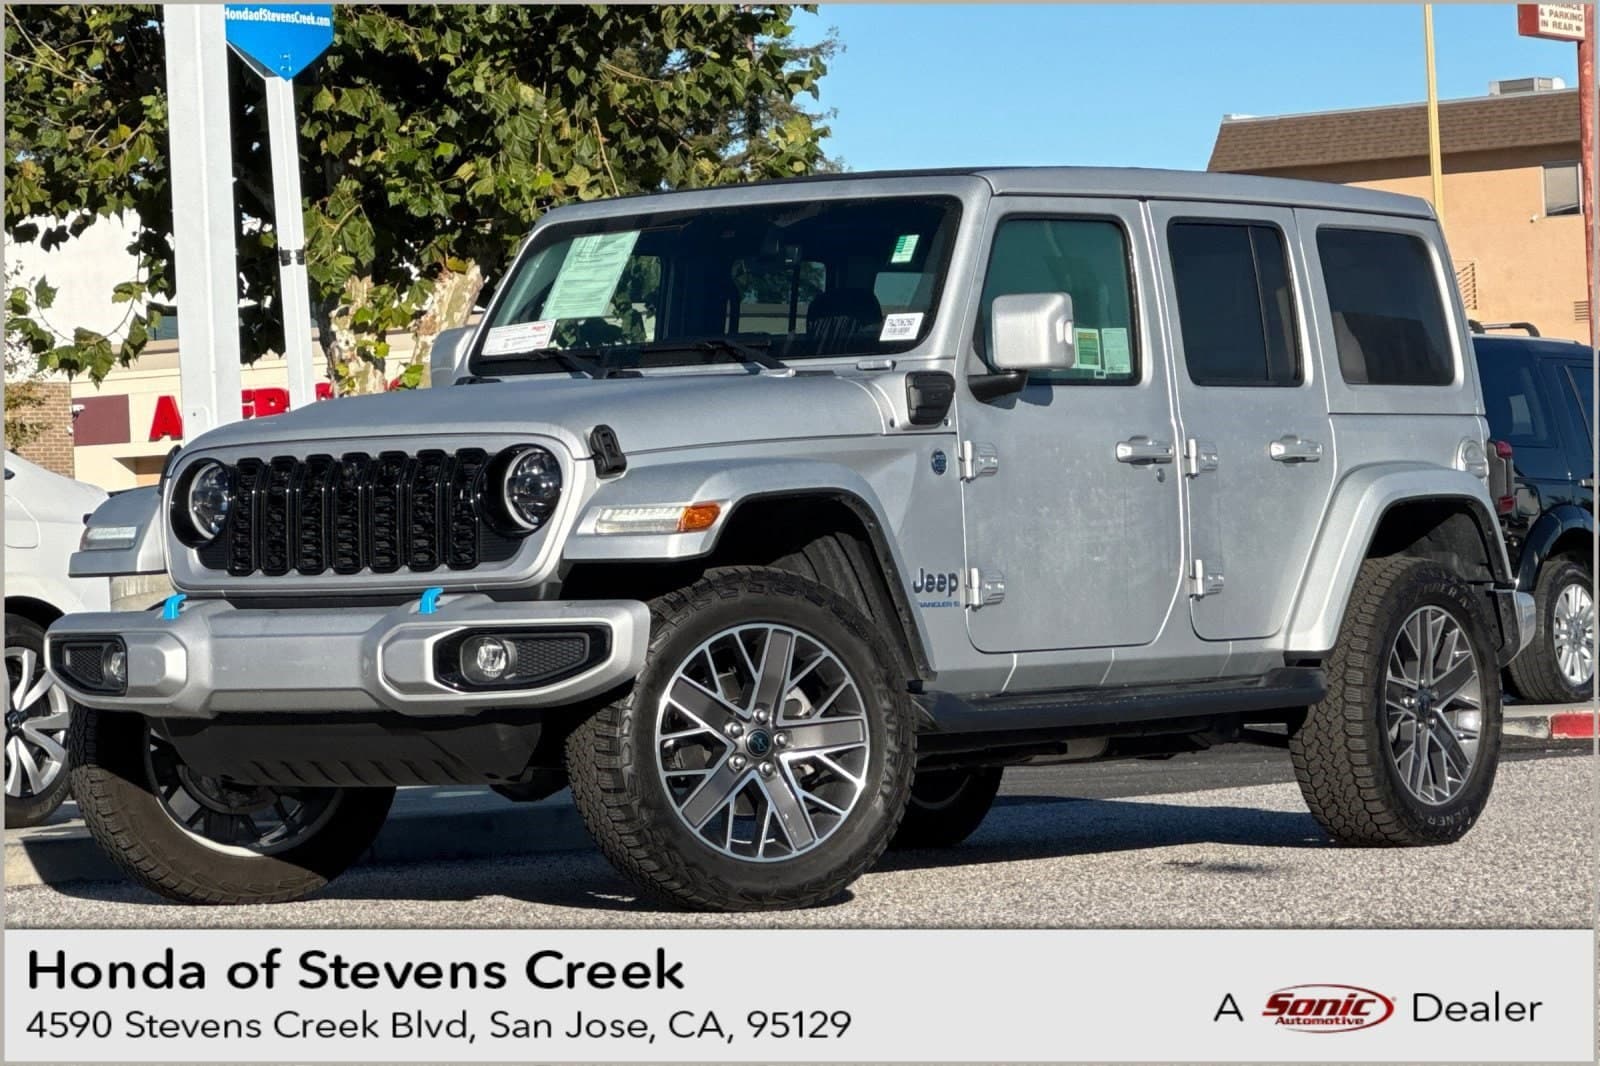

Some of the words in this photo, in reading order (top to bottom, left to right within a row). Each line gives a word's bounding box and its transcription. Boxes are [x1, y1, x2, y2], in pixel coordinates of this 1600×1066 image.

[224, 7, 331, 27] HondaofStevensCreek.com
[1549, 9, 1583, 22] PARKING
[1552, 21, 1574, 31] REAR
[913, 567, 958, 597] Jeep
